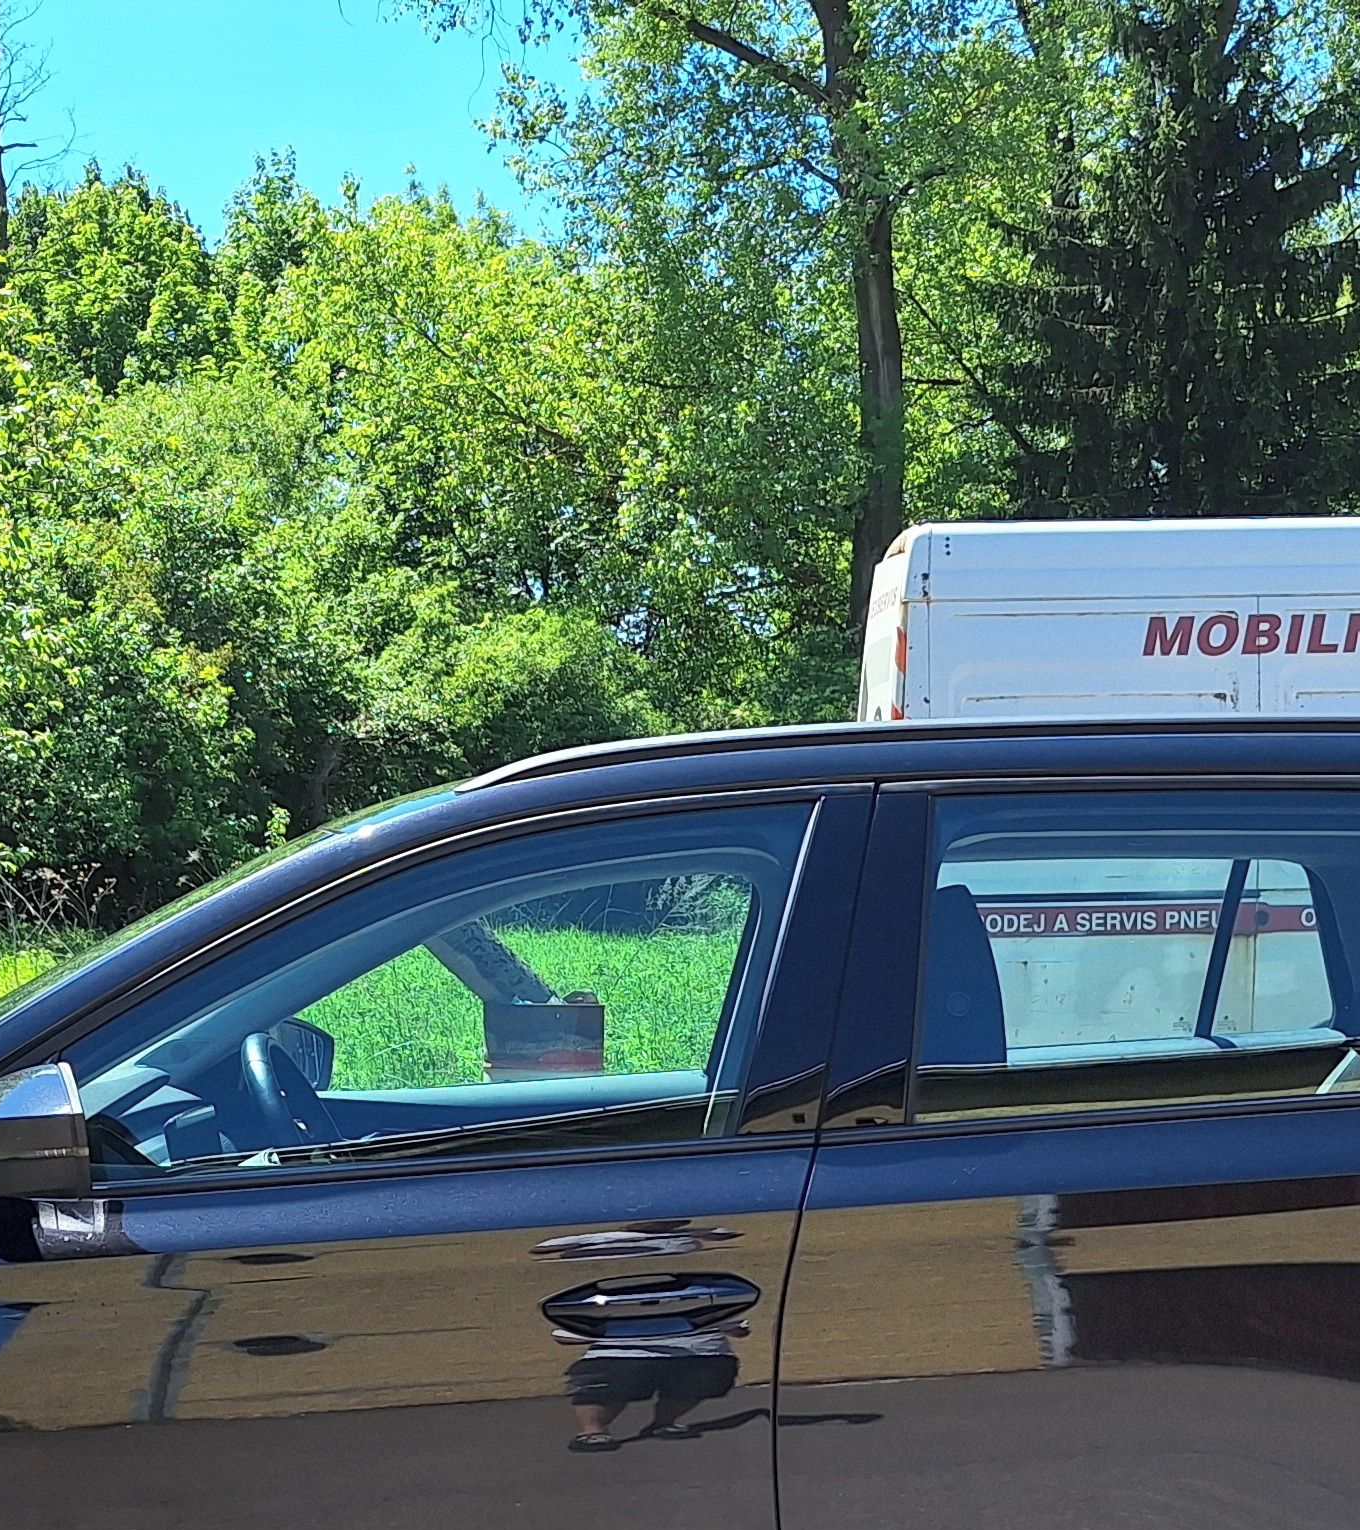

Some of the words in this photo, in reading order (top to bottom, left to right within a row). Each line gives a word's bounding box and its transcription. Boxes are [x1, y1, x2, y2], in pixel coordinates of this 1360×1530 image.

[981, 913, 1045, 933] ODEJ
[1053, 913, 1070, 932] A
[1075, 911, 1157, 932] SERVIS
